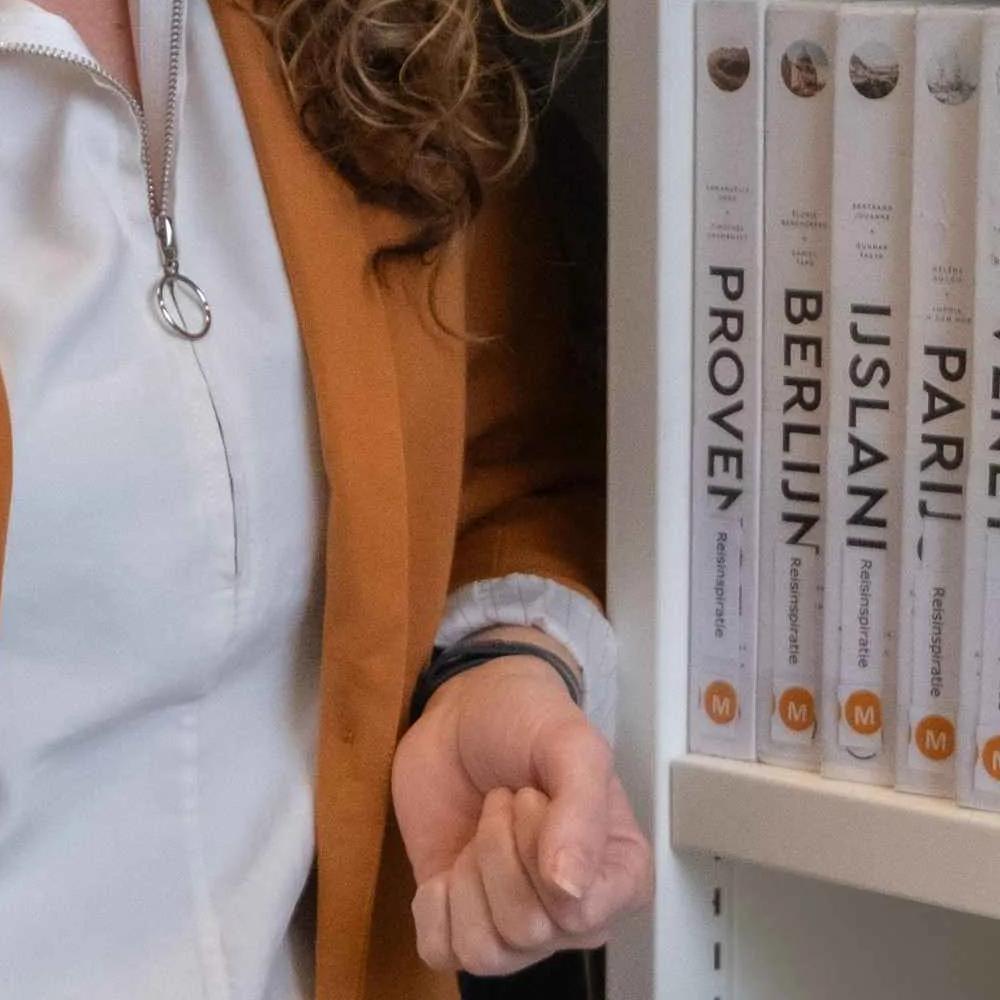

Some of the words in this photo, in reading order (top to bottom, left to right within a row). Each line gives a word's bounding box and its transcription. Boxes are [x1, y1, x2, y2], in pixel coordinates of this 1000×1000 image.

[707, 265, 745, 526] PROVEN
[781, 288, 823, 553] BERLIJN
[917, 345, 967, 561] PARIJ
[715, 532, 728, 639] Reisinspiratie
[788, 557, 801, 665] Reisinspiratie
[857, 559, 873, 669] Reisinspiratie
[930, 586, 946, 698] Reisinspiratie
[712, 694, 731, 715] M
[787, 701, 808, 722] M
[854, 705, 875, 726] M
[925, 729, 947, 751] M
